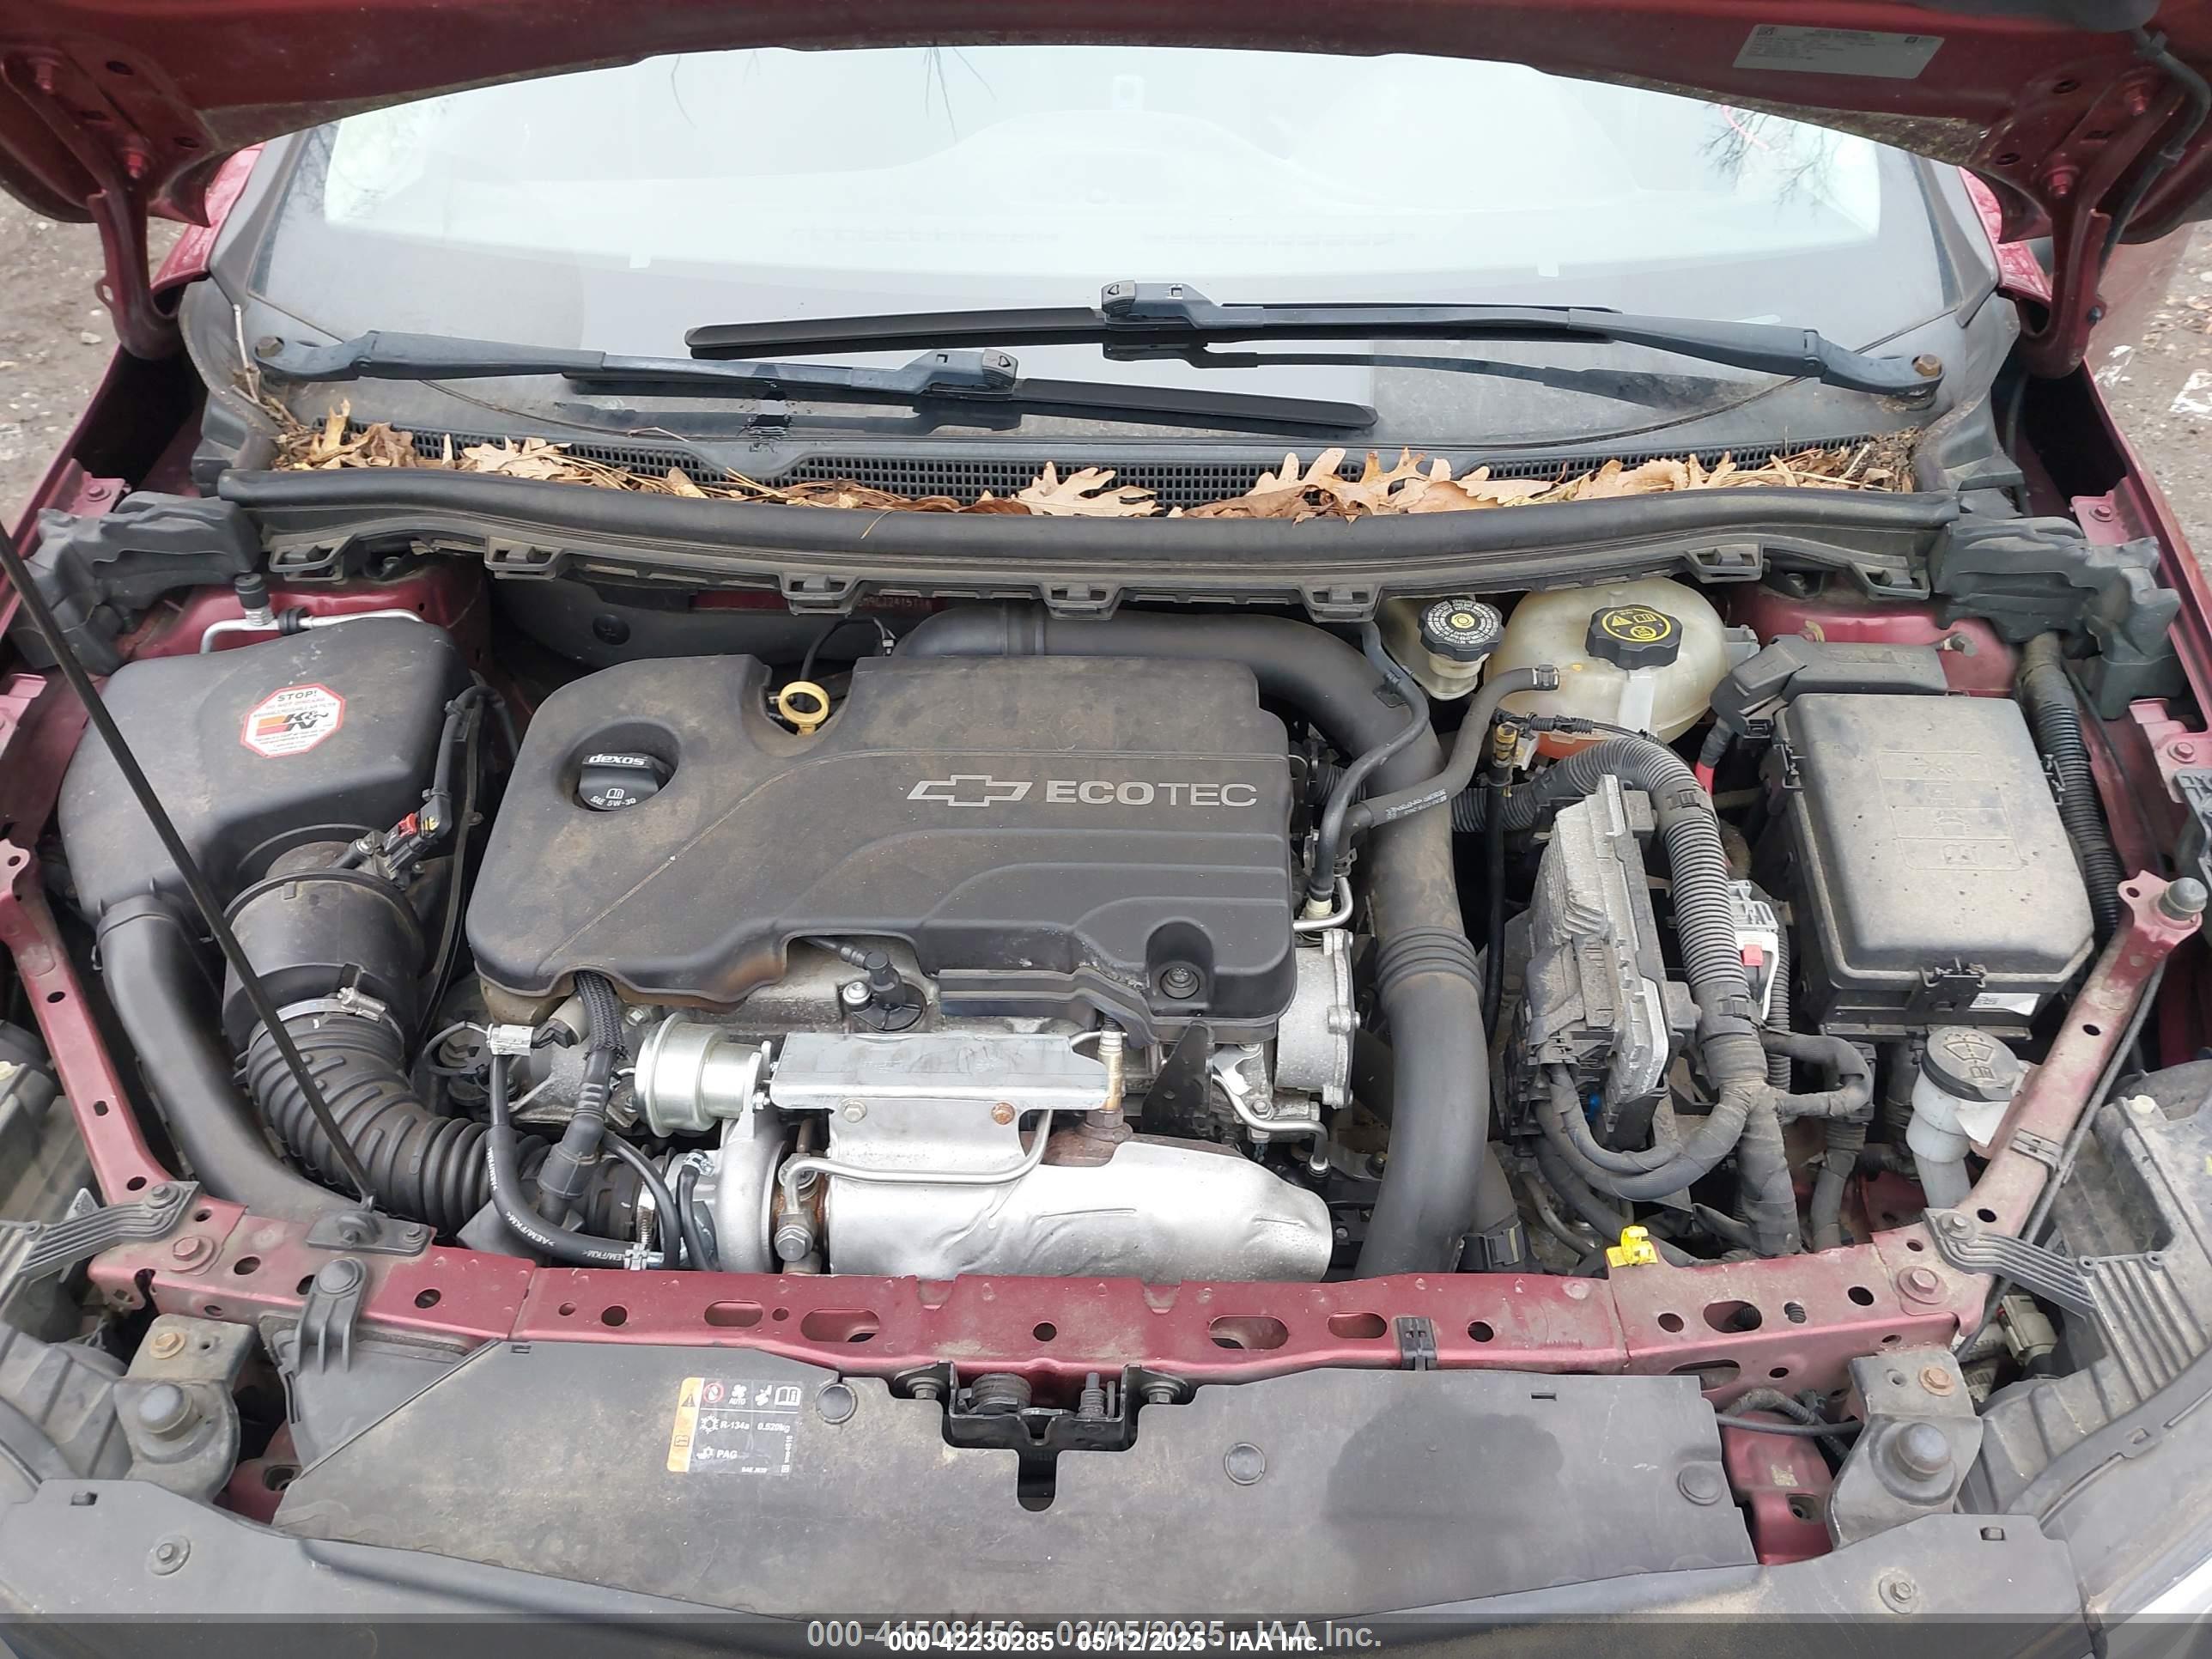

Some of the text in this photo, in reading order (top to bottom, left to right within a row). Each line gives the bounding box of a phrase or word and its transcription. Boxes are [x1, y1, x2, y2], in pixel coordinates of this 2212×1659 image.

[277, 690, 318, 702] STOP!
[588, 754, 646, 766] dexos
[1046, 780, 1258, 807] ECOTEC
[590, 796, 636, 806] SAE 5W-30
[729, 1397, 746, 1406] AUTO
[720, 1419, 791, 1432] R-134a 0.520kg
[717, 1449, 738, 1459] PAG
